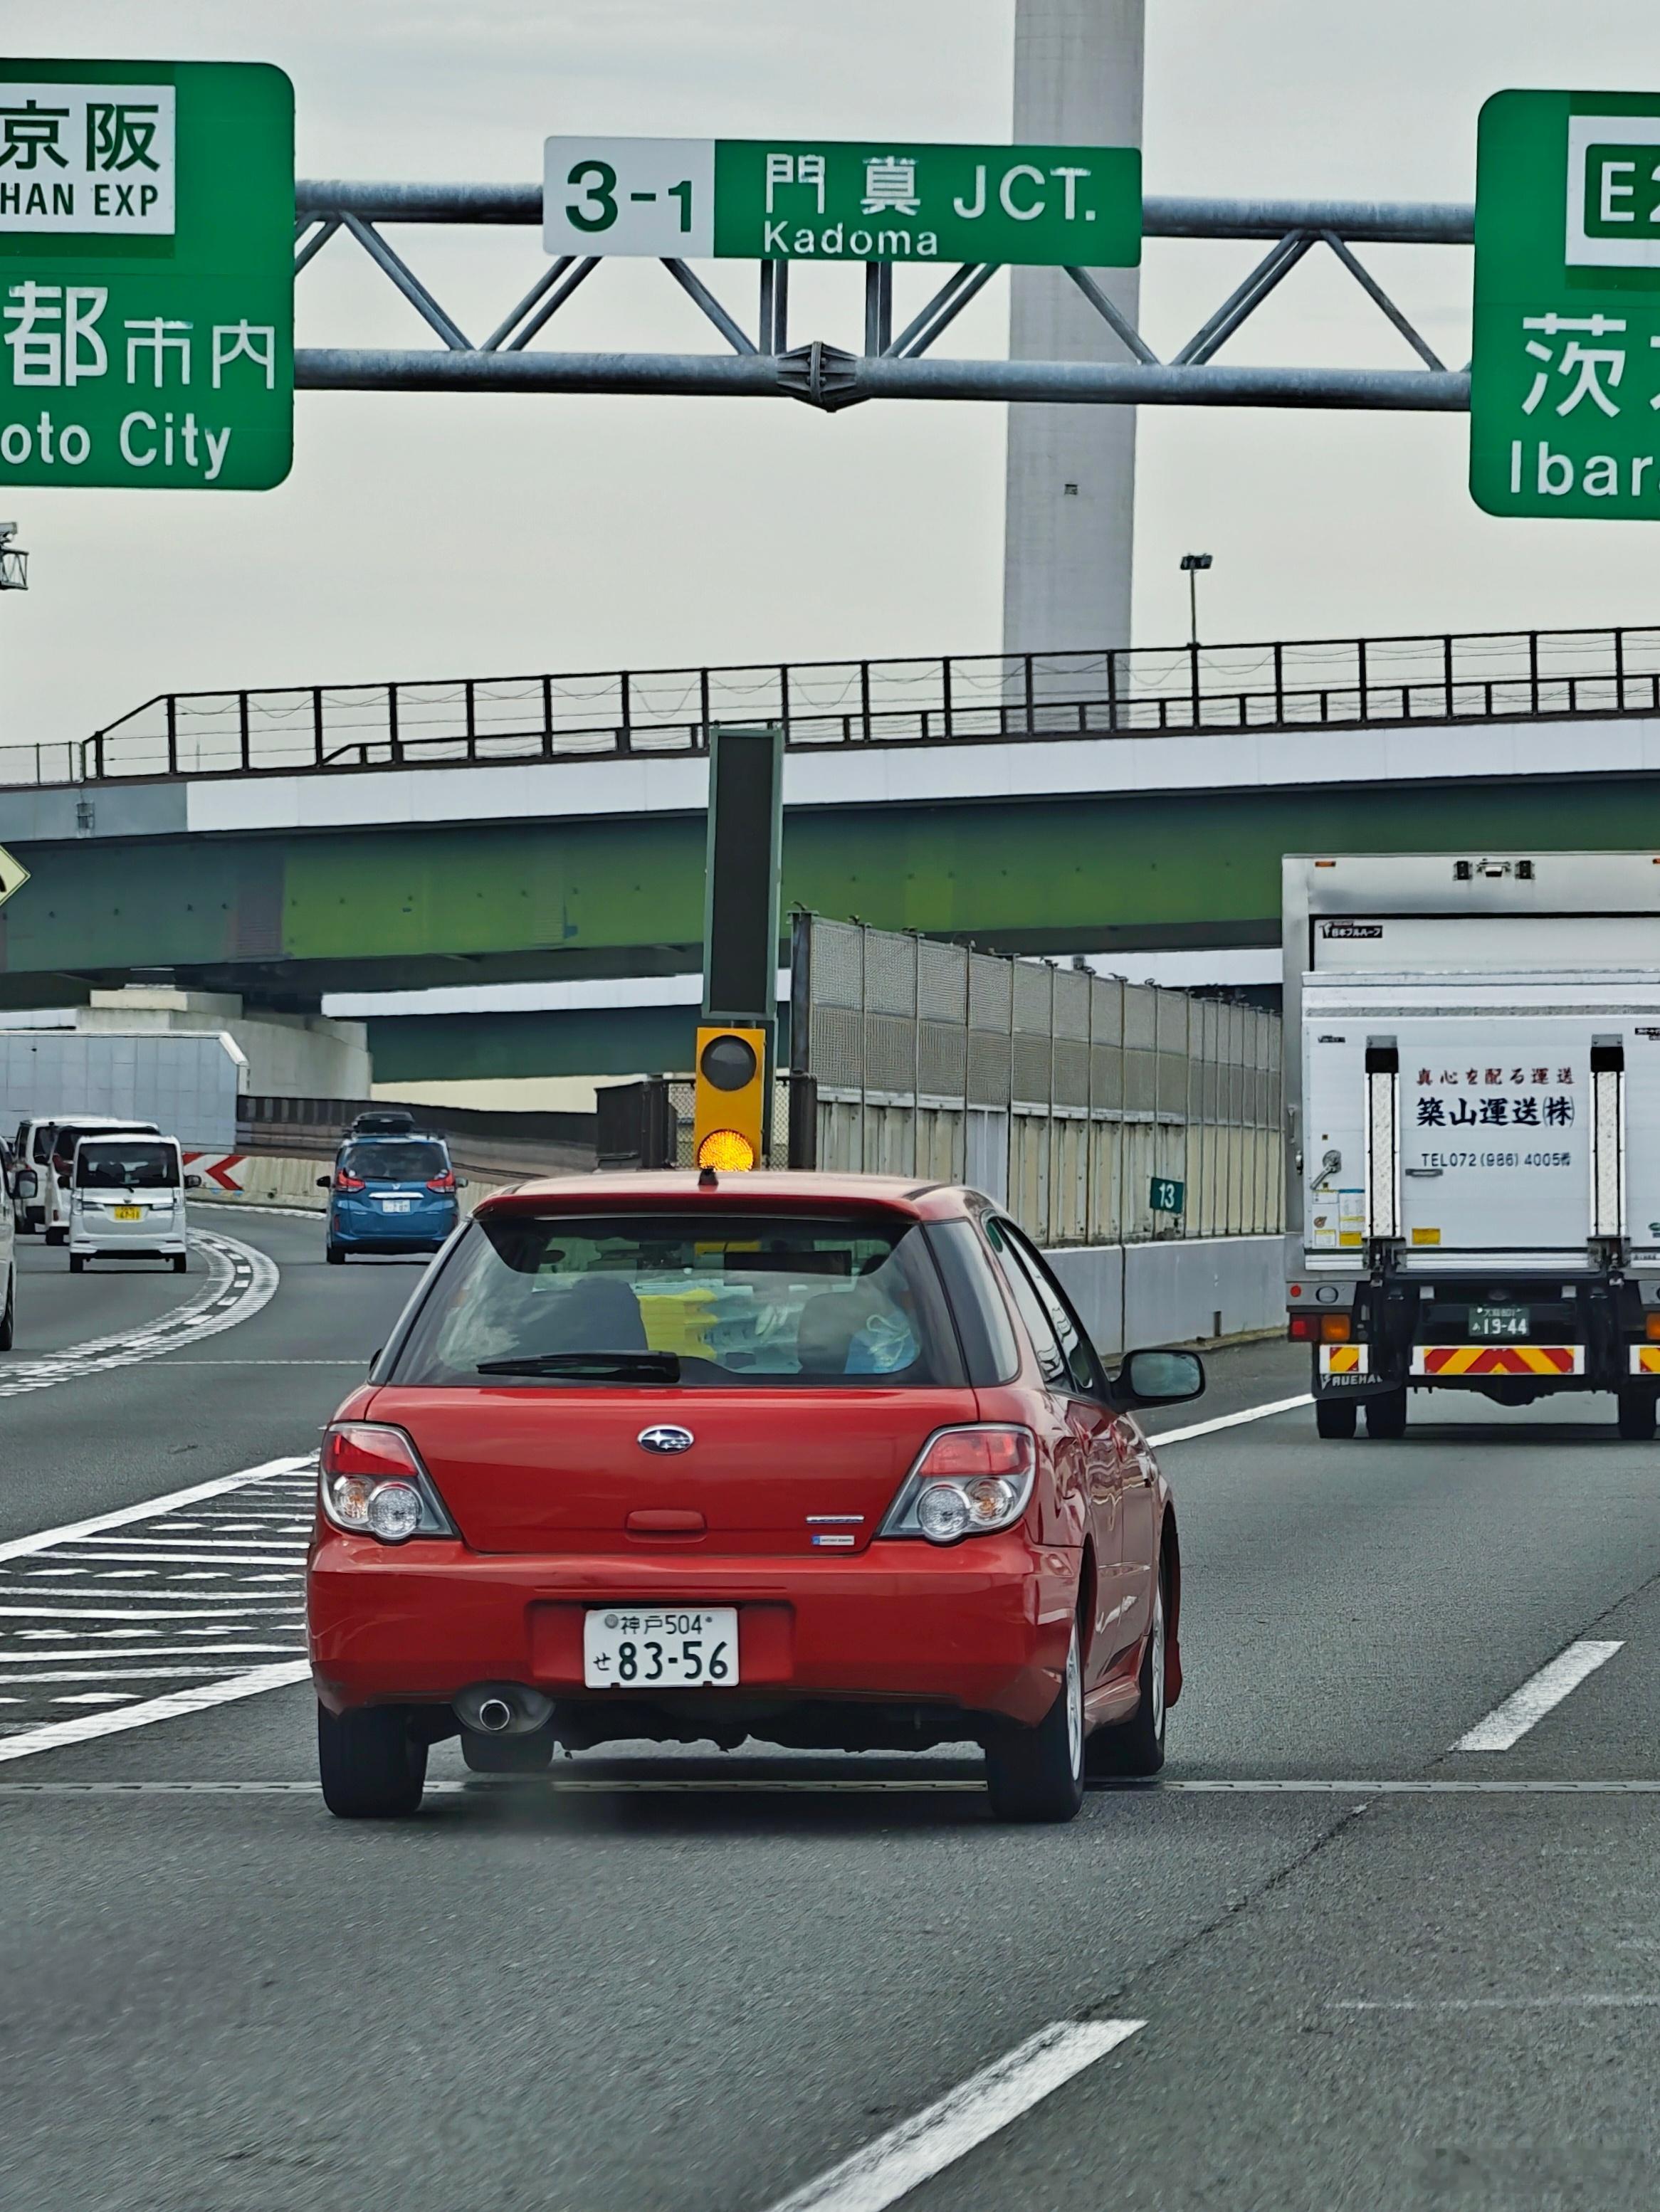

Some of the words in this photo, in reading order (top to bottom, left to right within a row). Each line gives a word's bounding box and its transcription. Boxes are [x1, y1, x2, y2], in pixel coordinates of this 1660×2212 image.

[0, 100, 161, 172] 京阪
[1, 182, 74, 216] HAN
[94, 184, 159, 216] EXP
[565, 160, 692, 233] 3-1
[953, 164, 1096, 221] JCT.
[764, 220, 938, 256] Kadoma
[3, 280, 275, 390] 都市内
[1521, 312, 1660, 418] 茨
[1, 411, 91, 465] oto
[120, 411, 231, 480] City
[1510, 440, 1660, 497] Ibar
[1417, 1067, 1575, 1086] 真心を配る運送
[1159, 1182, 1175, 1208] 13
[593, 1652, 611, 1671] せ
[619, 1640, 729, 1681] 83-56
